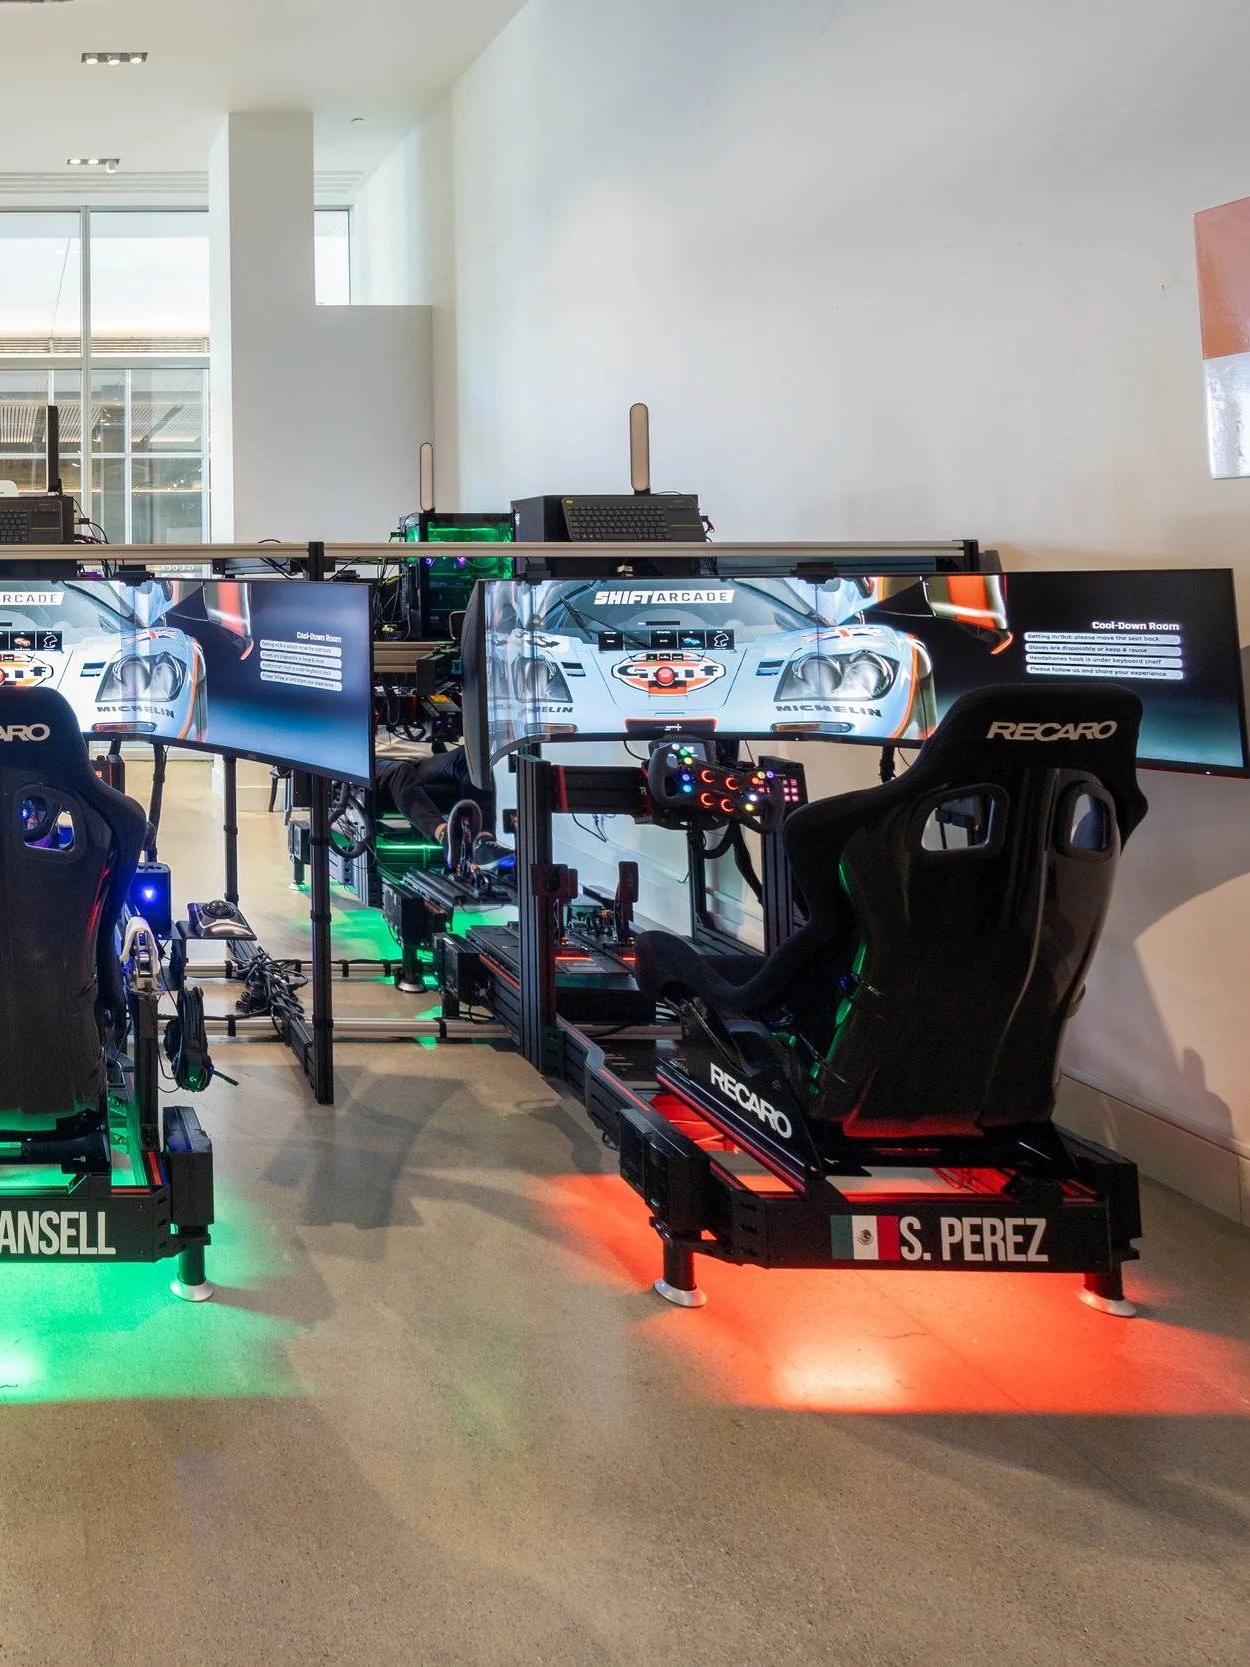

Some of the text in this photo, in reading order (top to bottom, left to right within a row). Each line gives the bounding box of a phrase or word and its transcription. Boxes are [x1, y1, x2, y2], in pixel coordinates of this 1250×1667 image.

[1092, 621, 1146, 630] Cool-Down
[297, 632, 341, 643] Cool-Down Room
[96, 705, 174, 718] MICHELIN
[775, 705, 882, 717] MICHELIN
[986, 720, 1118, 741] RECARO
[710, 1062, 792, 1138] RECARO
[900, 1216, 1049, 1262] S. PEREZ
